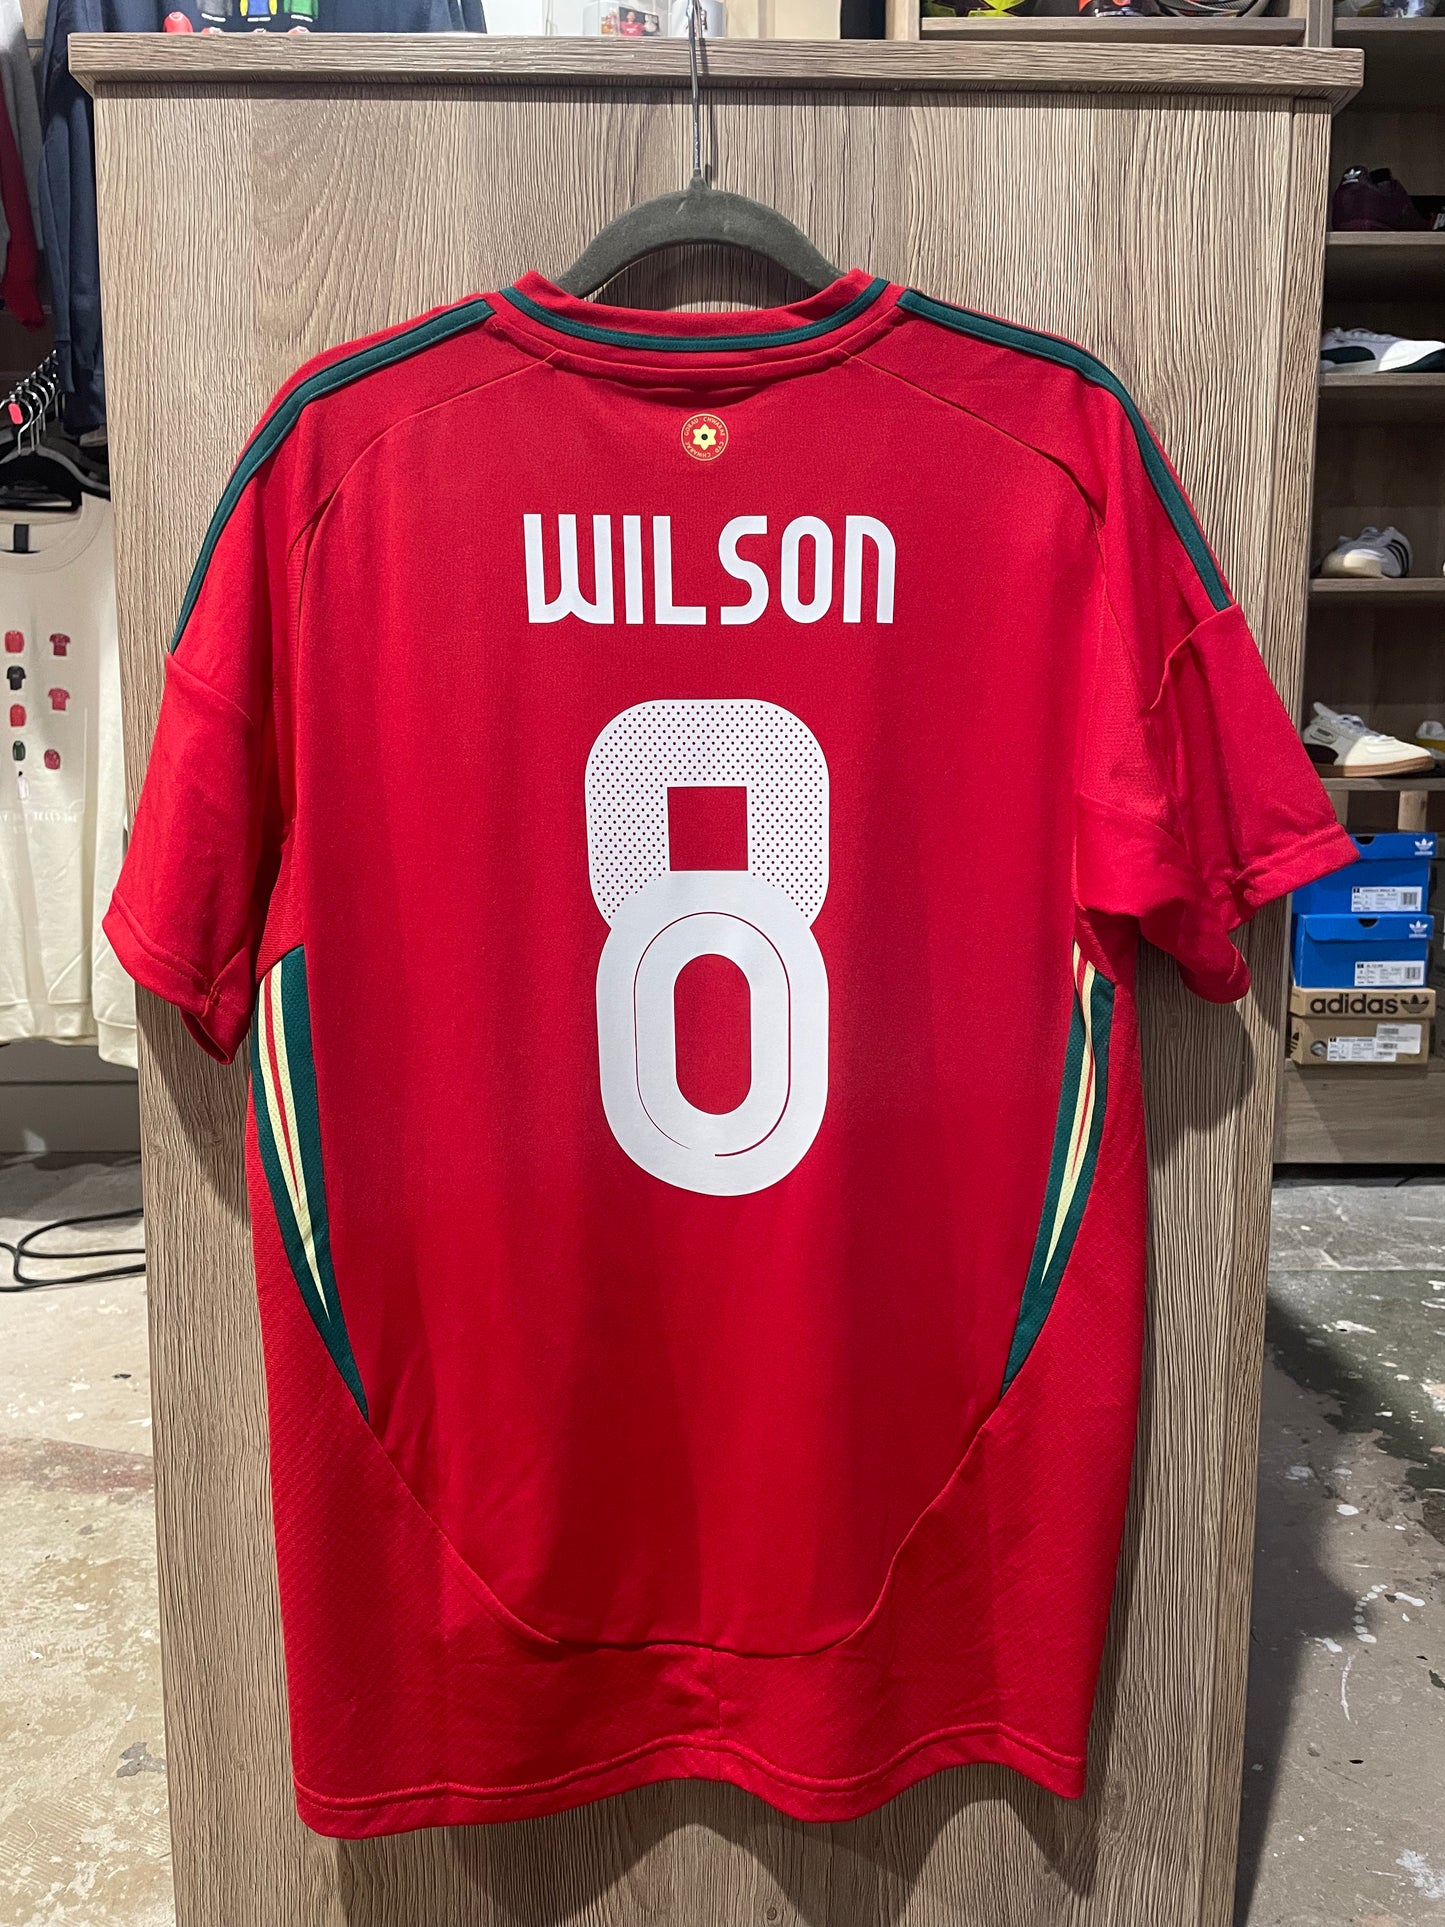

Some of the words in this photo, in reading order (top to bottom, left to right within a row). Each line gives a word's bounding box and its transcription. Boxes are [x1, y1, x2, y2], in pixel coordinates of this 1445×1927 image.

[522, 513, 897, 625] WILSON
[584, 699, 830, 1196] 8
[1310, 993, 1398, 1014] adidas
